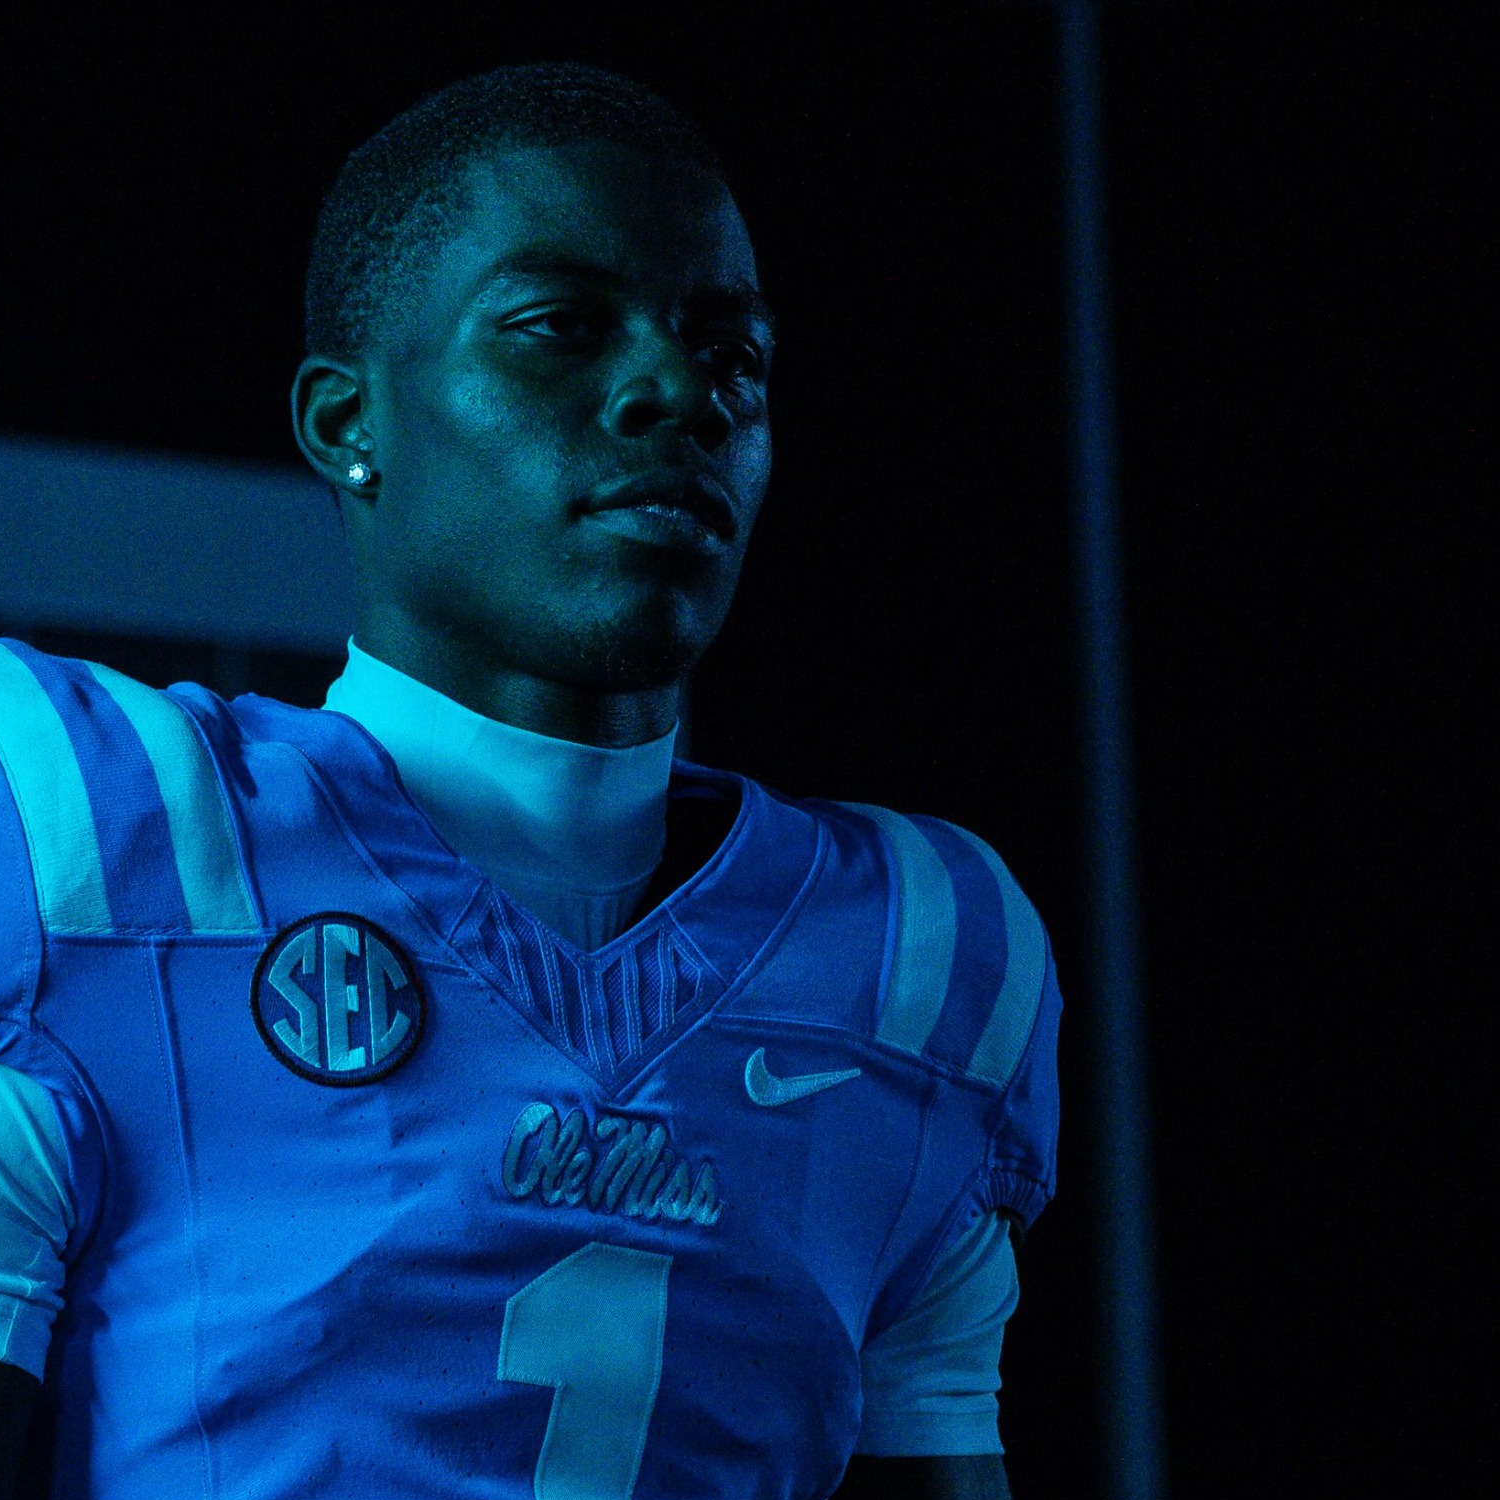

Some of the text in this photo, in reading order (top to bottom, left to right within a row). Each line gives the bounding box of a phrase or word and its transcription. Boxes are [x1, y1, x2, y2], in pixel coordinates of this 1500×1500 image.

[268, 923, 411, 1072] SEC
[503, 1101, 725, 1226] Ole Miss
